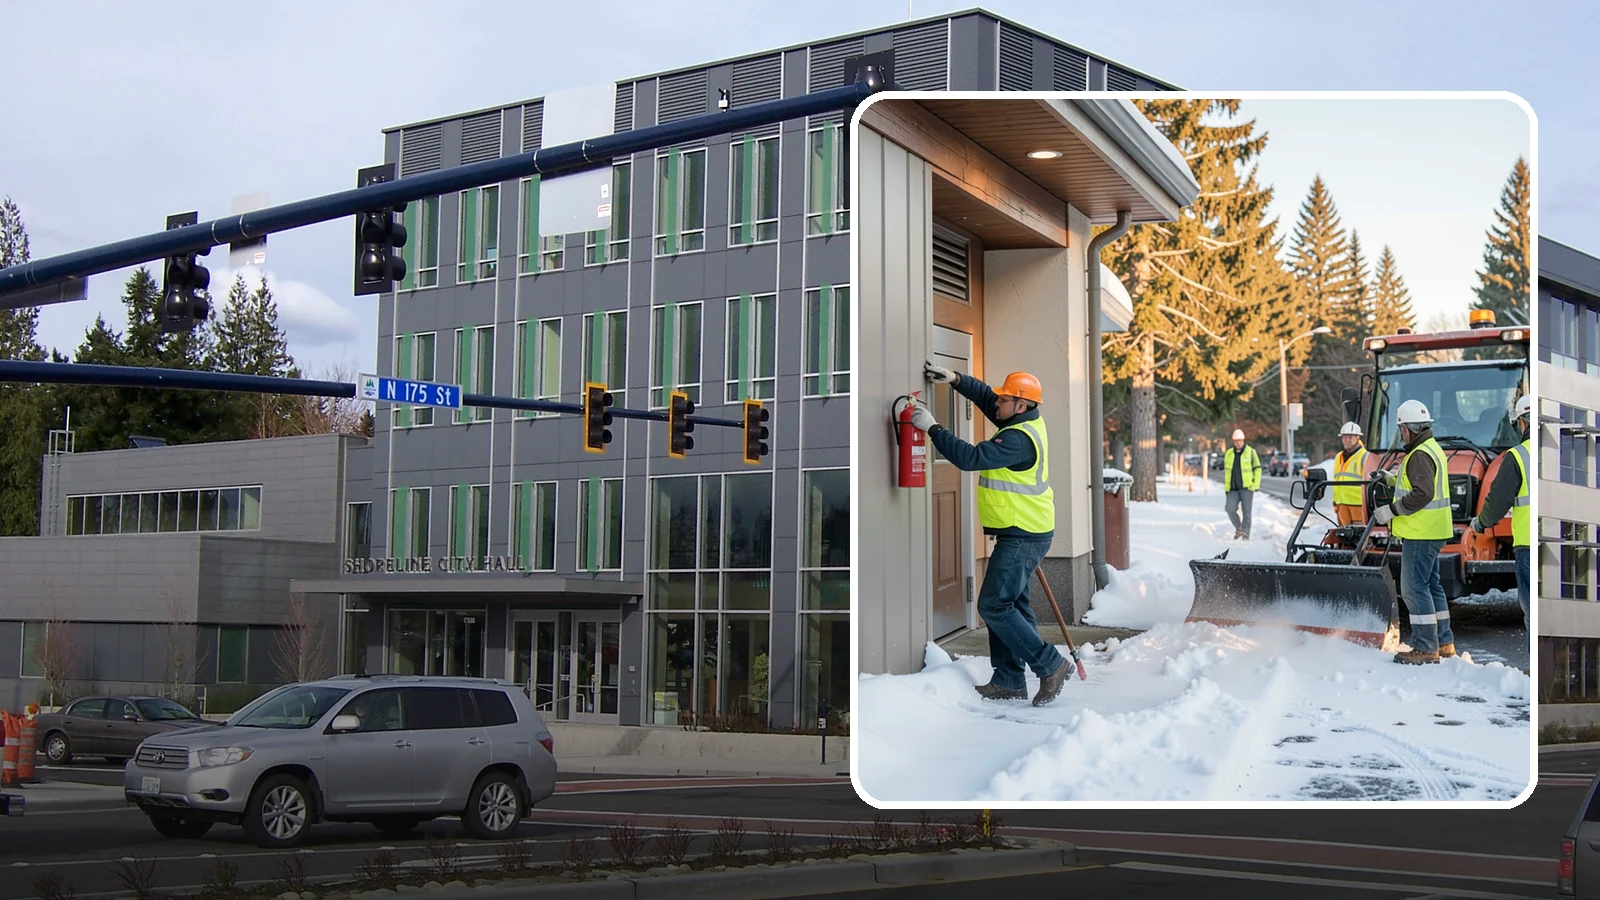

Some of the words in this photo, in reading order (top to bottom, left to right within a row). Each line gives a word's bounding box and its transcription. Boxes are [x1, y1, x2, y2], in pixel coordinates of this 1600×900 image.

[387, 380, 396, 399] N
[405, 383, 427, 403] 175
[436, 387, 451, 406] St
[343, 557, 431, 574] SHORELINE
[438, 556, 475, 571] CITY
[484, 555, 525, 571] HALL
